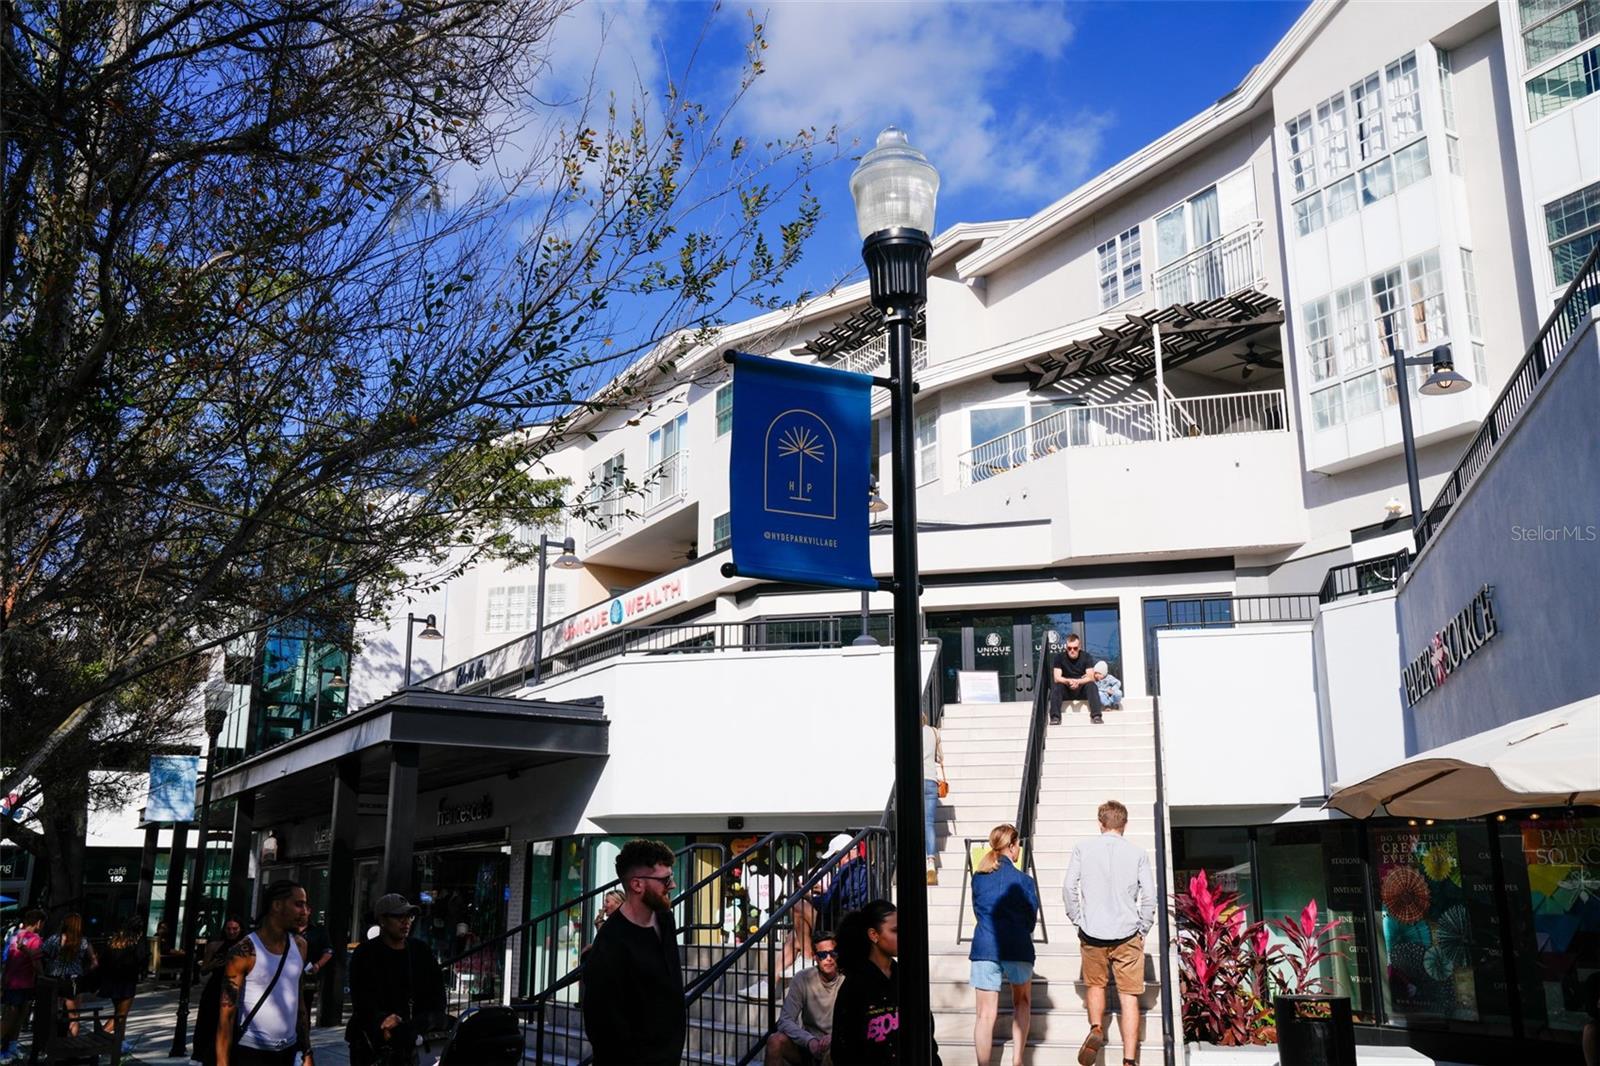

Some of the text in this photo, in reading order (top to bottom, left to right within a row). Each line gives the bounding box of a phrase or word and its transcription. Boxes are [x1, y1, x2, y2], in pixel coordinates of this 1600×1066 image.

[788, 481, 813, 493] H P
[764, 531, 838, 549] @HYDEPARKVILLAGE
[563, 578, 682, 642] UNIQUE WEALTH
[1402, 583, 1498, 709] PAPER SOURCE
[1540, 828, 1600, 846] PAPER
[1381, 840, 1454, 854] CREATIVE
[1383, 855, 1422, 864] EVERY
[108, 867, 127, 876] café
